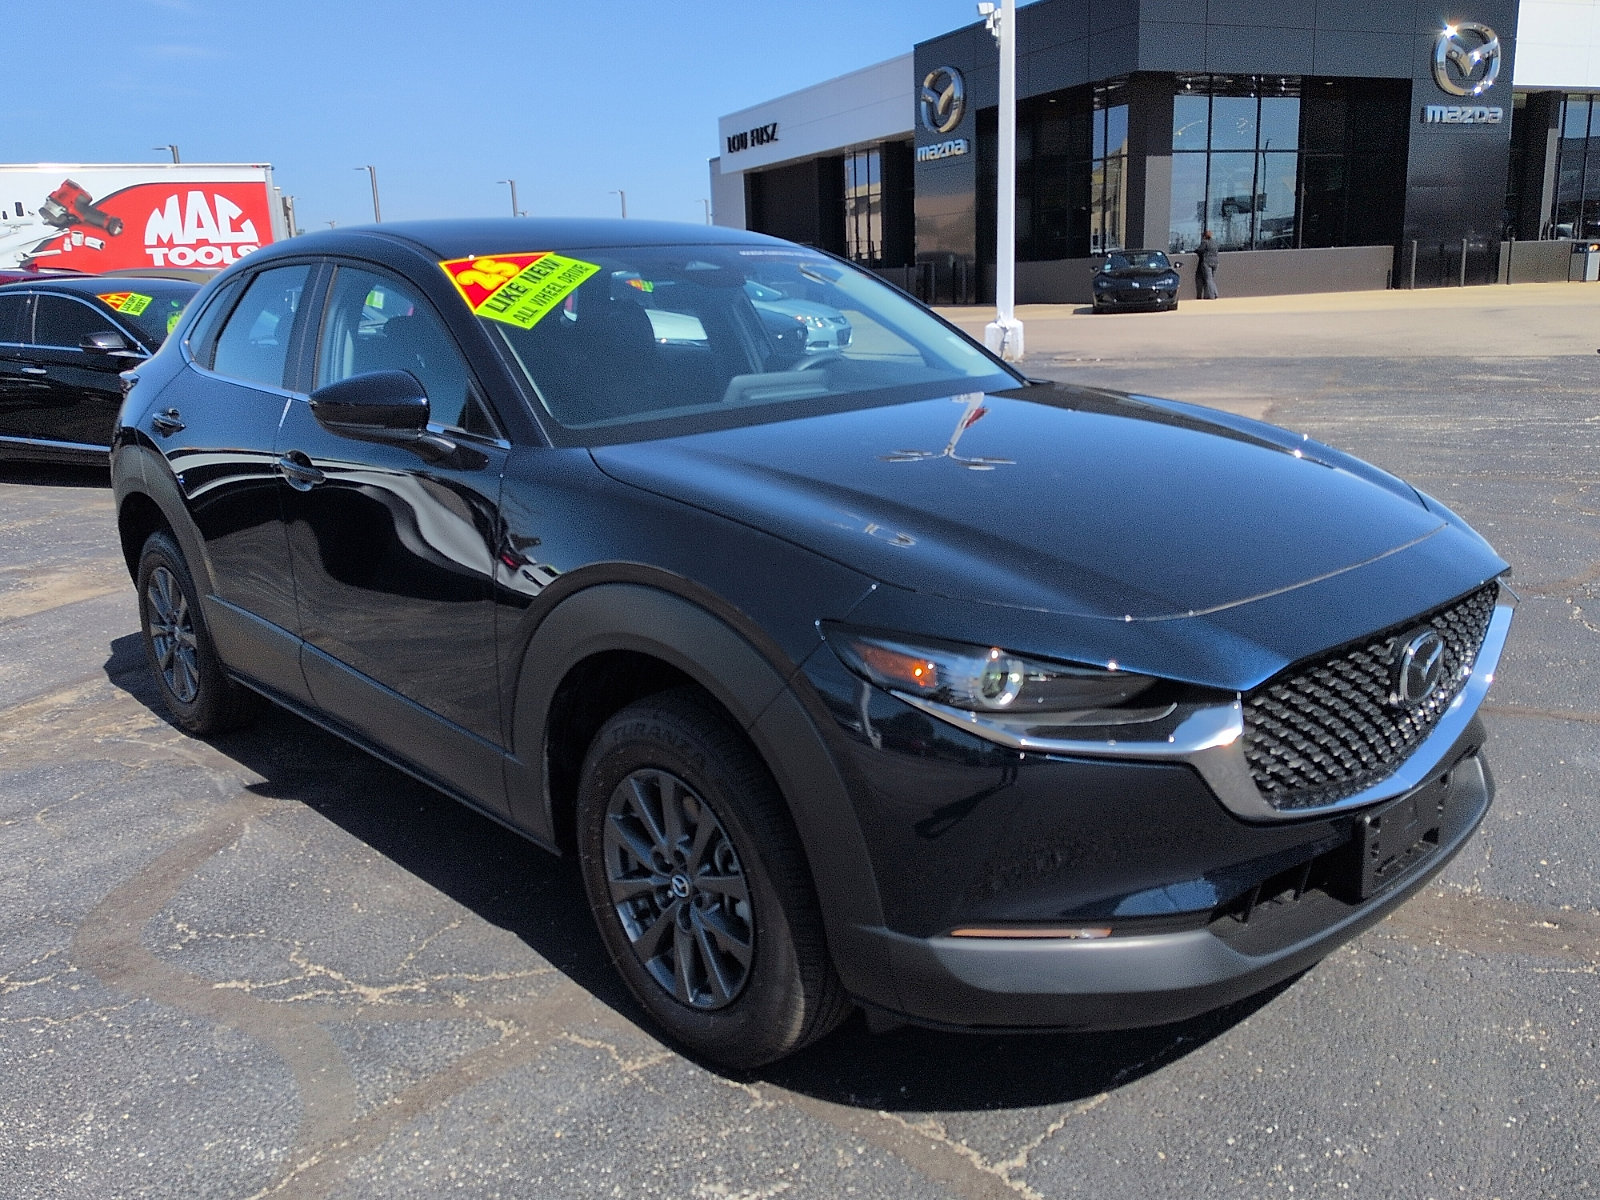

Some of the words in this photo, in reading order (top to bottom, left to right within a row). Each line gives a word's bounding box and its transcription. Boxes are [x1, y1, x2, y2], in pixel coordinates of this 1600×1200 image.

[1425, 104, 1503, 124] mazda
[726, 131, 748, 154] LOU
[749, 121, 779, 147] FUSZ
[916, 138, 968, 162] mazda
[144, 190, 259, 246] MAC
[455, 258, 520, 291] 25
[484, 282, 529, 313] LIKE
[519, 257, 562, 284] NEW
[512, 305, 540, 324] ALL
[528, 281, 567, 307] WHEEL
[556, 263, 590, 283] DRIVE
